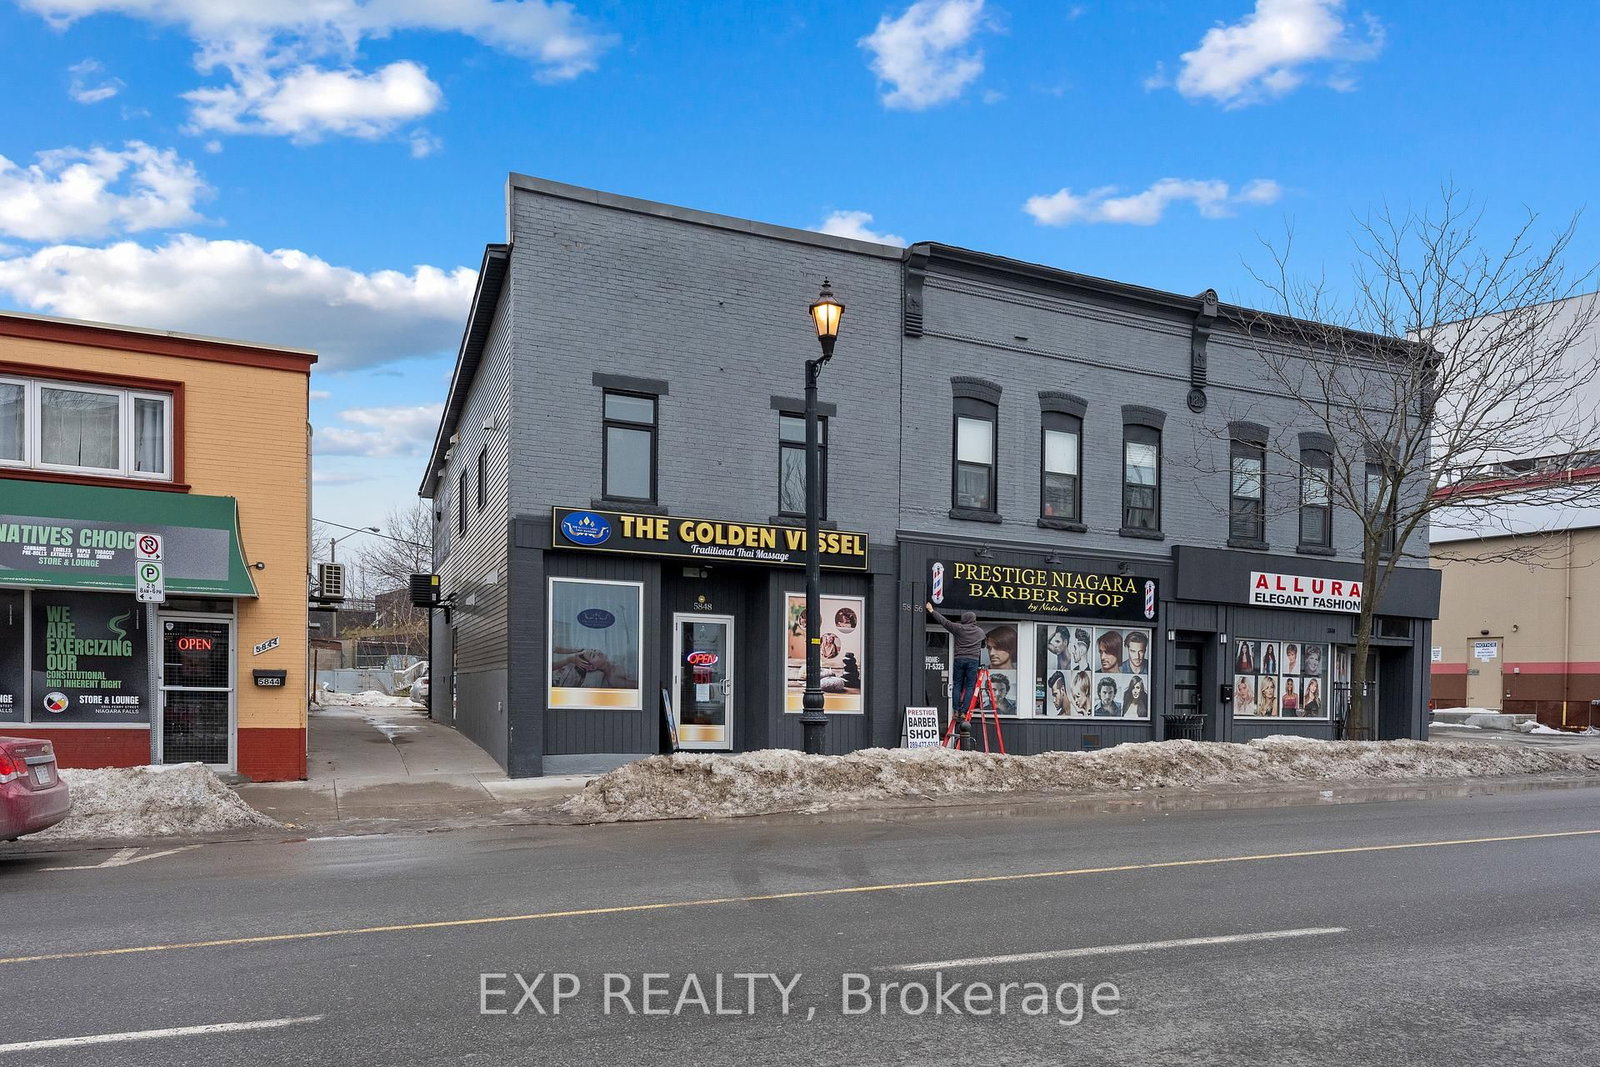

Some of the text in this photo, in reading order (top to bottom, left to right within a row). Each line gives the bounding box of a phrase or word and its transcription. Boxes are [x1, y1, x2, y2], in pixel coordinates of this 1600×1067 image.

[0, 523, 136, 550] NATIVES CHOIC
[620, 515, 670, 541] THE
[678, 520, 776, 549] GOLDEN
[691, 544, 790, 563] Traditional Thai Massage
[38, 557, 62, 566] STORE
[71, 559, 100, 568] LOUNGE
[953, 562, 1138, 594] PRESTIGE NIAGARA
[1255, 574, 1361, 598] ALLURA
[968, 583, 1124, 607] BARBER SHOP
[1254, 592, 1361, 611] ELEGANT FASHION
[693, 602, 713, 611] 5848
[1027, 602, 1070, 613] by Natalie
[46, 605, 71, 623] WE
[46, 622, 76, 639] ARE
[46, 638, 133, 656] EXERCIZING
[178, 638, 212, 650] OPEN
[46, 654, 77, 671] OUR
[689, 653, 718, 664] OPEN
[46, 671, 107, 680] CONSTITUTIONAL
[258, 678, 280, 686] 5844
[46, 680, 122, 689] AND INHERENT RIGHT
[79, 695, 140, 705] STORE & LOUNGE
[908, 717, 937, 728] BARBER
[909, 729, 938, 739] SHOP
